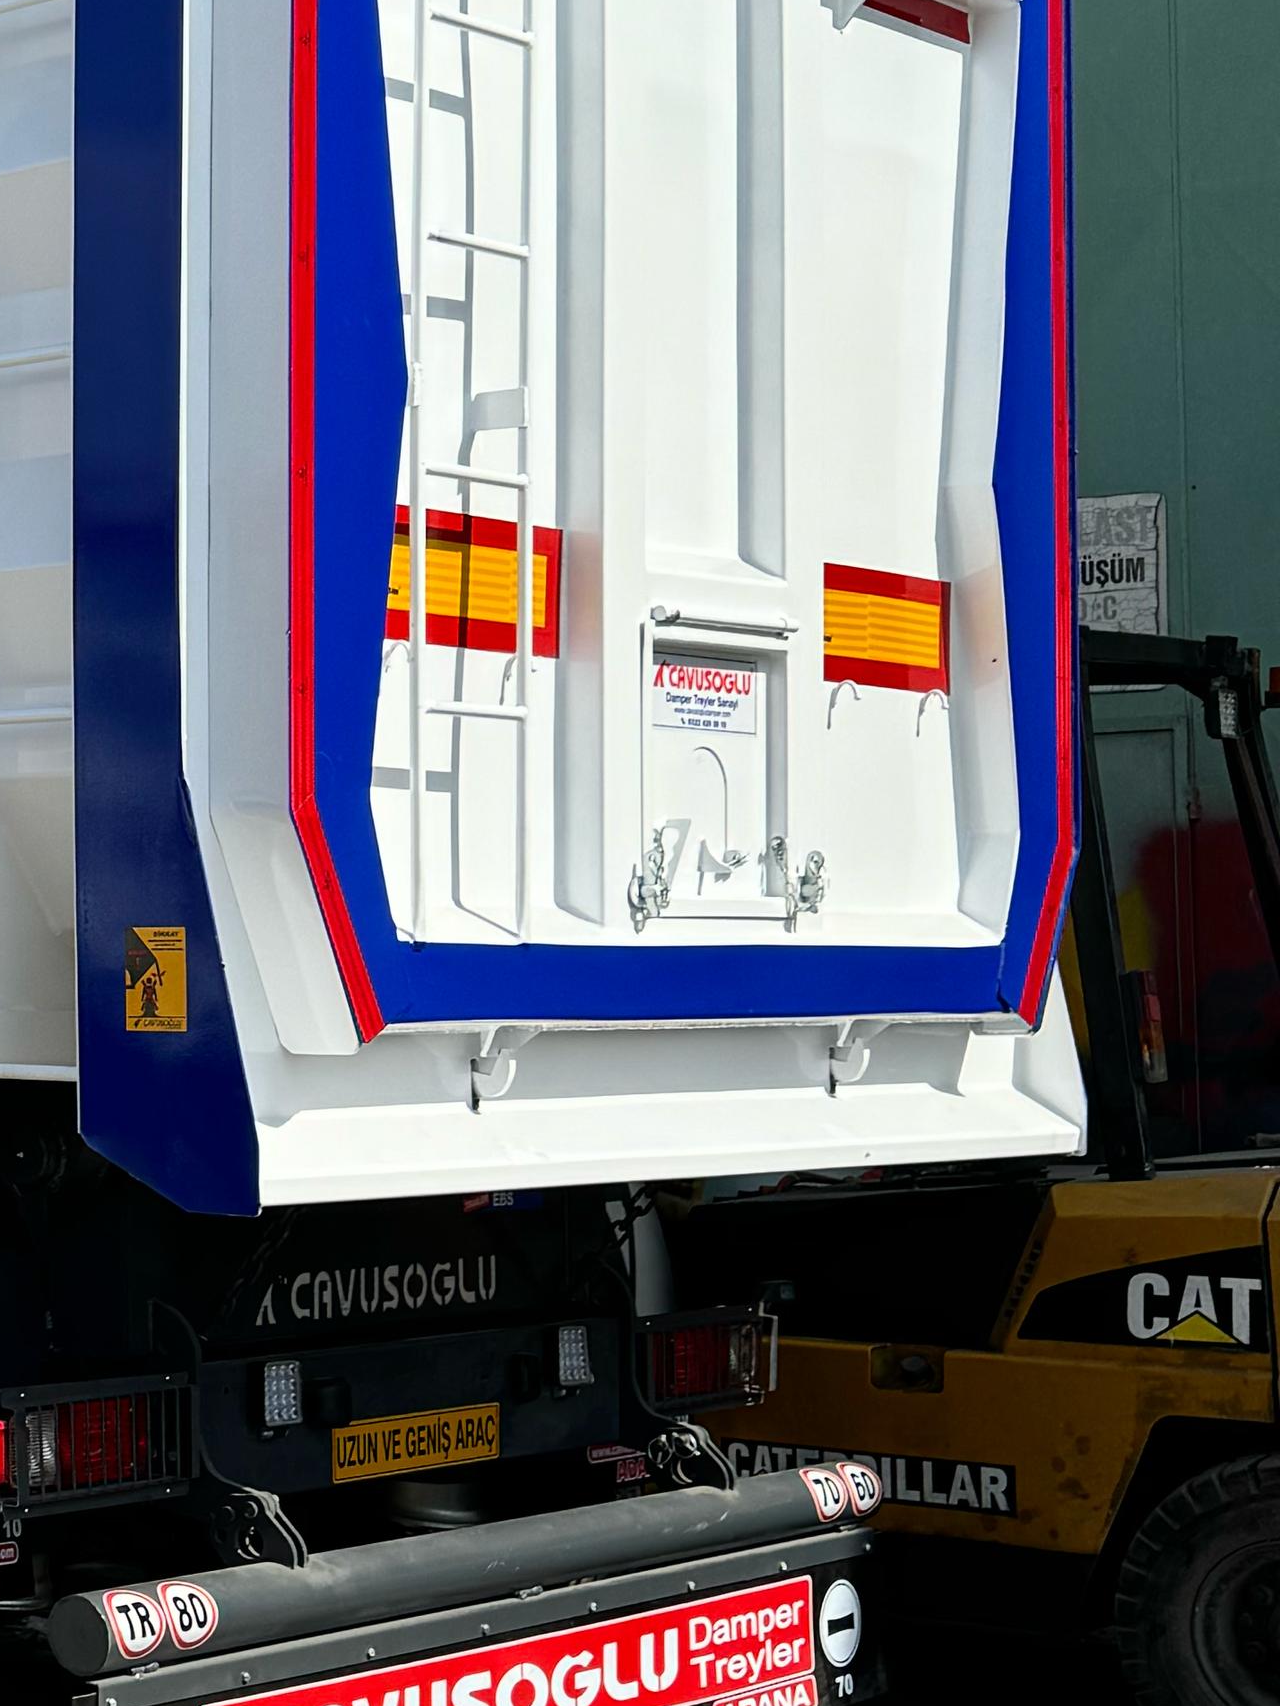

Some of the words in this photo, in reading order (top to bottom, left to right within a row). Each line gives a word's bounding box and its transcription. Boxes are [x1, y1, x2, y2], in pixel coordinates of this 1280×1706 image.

[1127, 1272, 1262, 1345] CAT
[336, 1431, 378, 1469] UZUN
[382, 1428, 402, 1462] VE
[405, 1416, 451, 1460] GENİŞ
[455, 1414, 496, 1453] ARAÇ
[812, 1477, 841, 1507] 70
[850, 1471, 876, 1501] 60
[3, 1518, 22, 1539] 10
[115, 1601, 157, 1641] TR
[172, 1592, 208, 1632] 80
[688, 1599, 805, 1651] Damper
[689, 1637, 806, 1689] Treyler
[834, 1673, 854, 1698] 70
